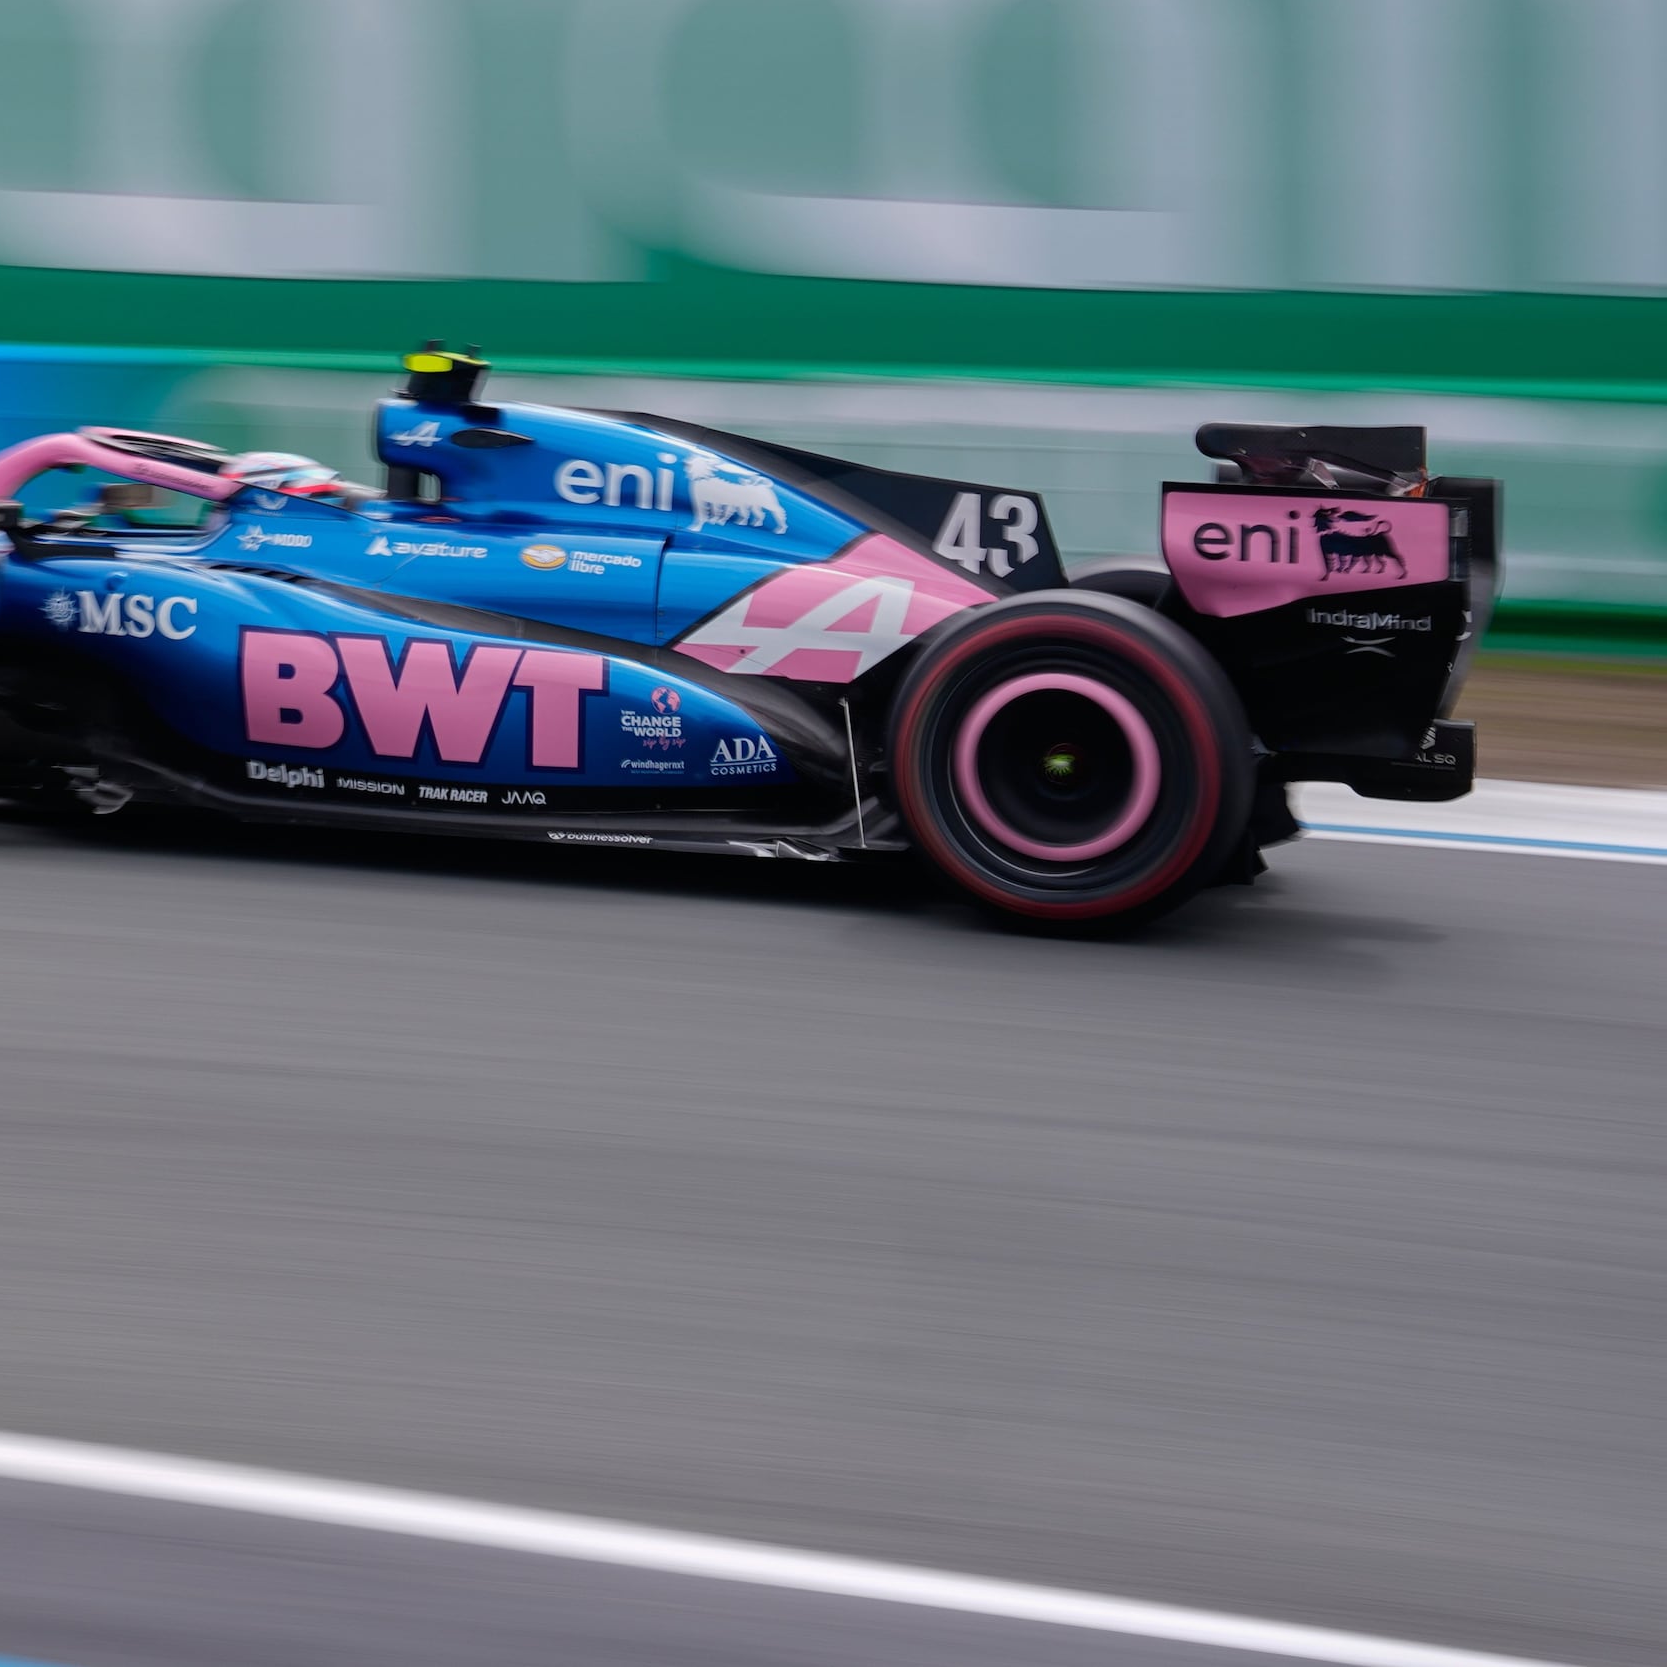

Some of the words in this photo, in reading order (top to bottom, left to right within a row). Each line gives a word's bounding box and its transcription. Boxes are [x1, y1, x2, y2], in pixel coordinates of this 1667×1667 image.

[554, 452, 677, 512] eni
[932, 491, 1039, 578] 43
[1194, 510, 1300, 564] eni
[392, 541, 488, 559] avature
[570, 550, 642, 568] mercado
[570, 560, 605, 575] libre
[76, 590, 197, 640] MSC
[1307, 607, 1432, 632] IndraMind
[242, 630, 605, 769] BWT
[621, 716, 682, 727] CHANGE
[633, 727, 682, 738] WORLD
[709, 735, 777, 762] ADA
[246, 759, 325, 788] Delphi
[711, 763, 777, 776] COSMETICS
[337, 776, 405, 796] MISSION
[418, 786, 449, 801] TRAK
[449, 789, 488, 803] RACER
[501, 790, 547, 805] JAAQ
